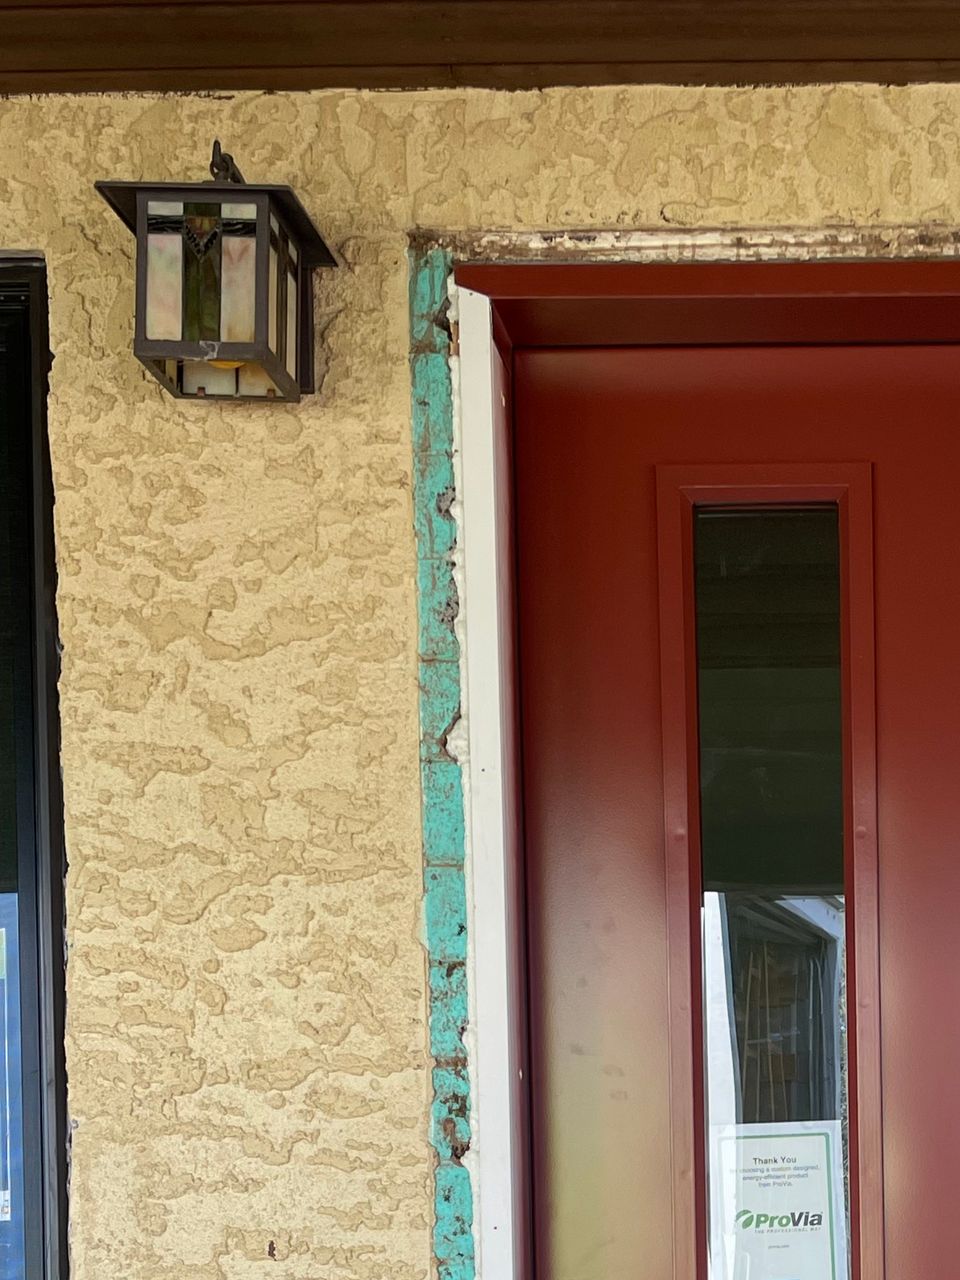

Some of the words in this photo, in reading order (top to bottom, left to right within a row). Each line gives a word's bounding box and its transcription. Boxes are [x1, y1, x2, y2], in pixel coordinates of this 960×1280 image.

[753, 1157, 778, 1165] Thank
[780, 1156, 797, 1164] You
[755, 1211, 822, 1228] ProVia
